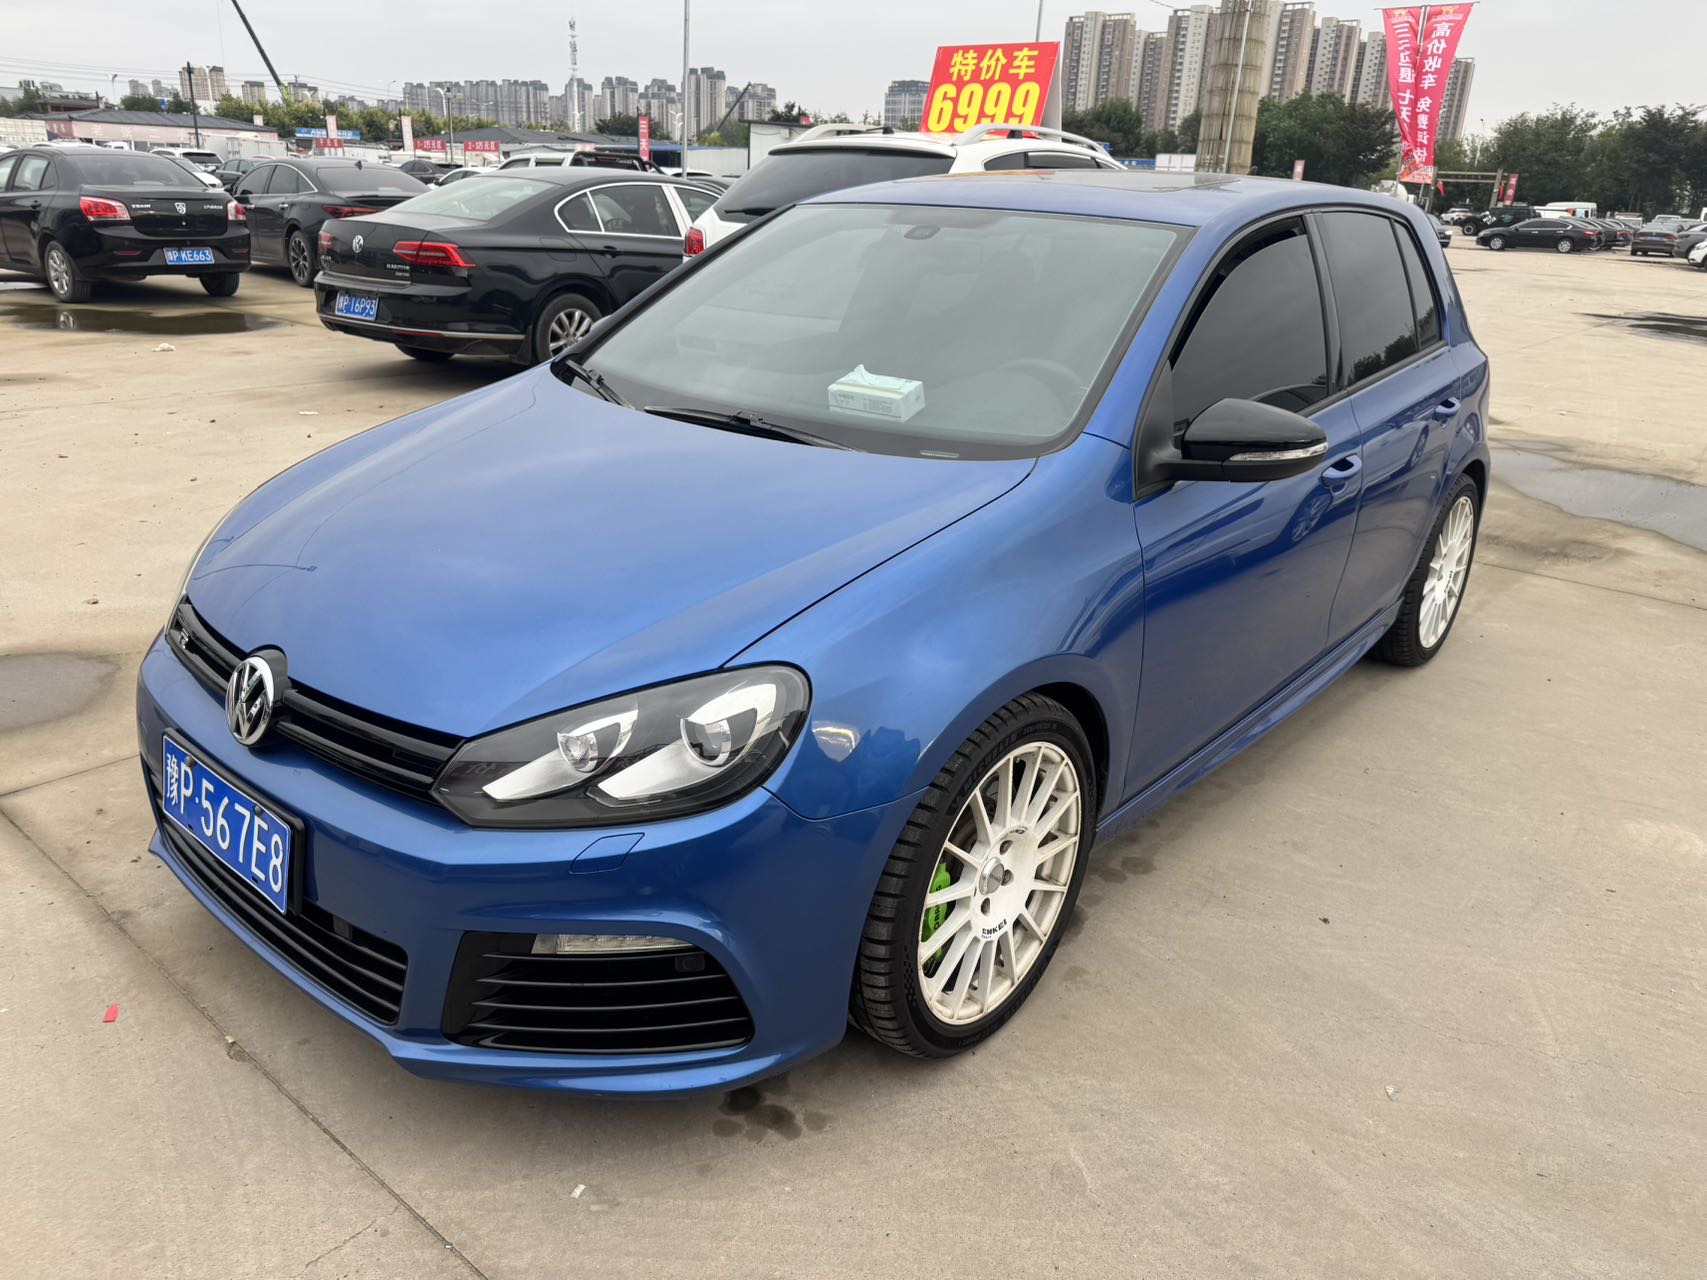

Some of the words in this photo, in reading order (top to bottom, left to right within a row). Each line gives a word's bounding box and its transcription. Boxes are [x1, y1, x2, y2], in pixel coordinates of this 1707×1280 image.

[949, 47, 1039, 81] 特价车
[927, 81, 1040, 133] 6999
[982, 918, 1007, 935] ENKEI
